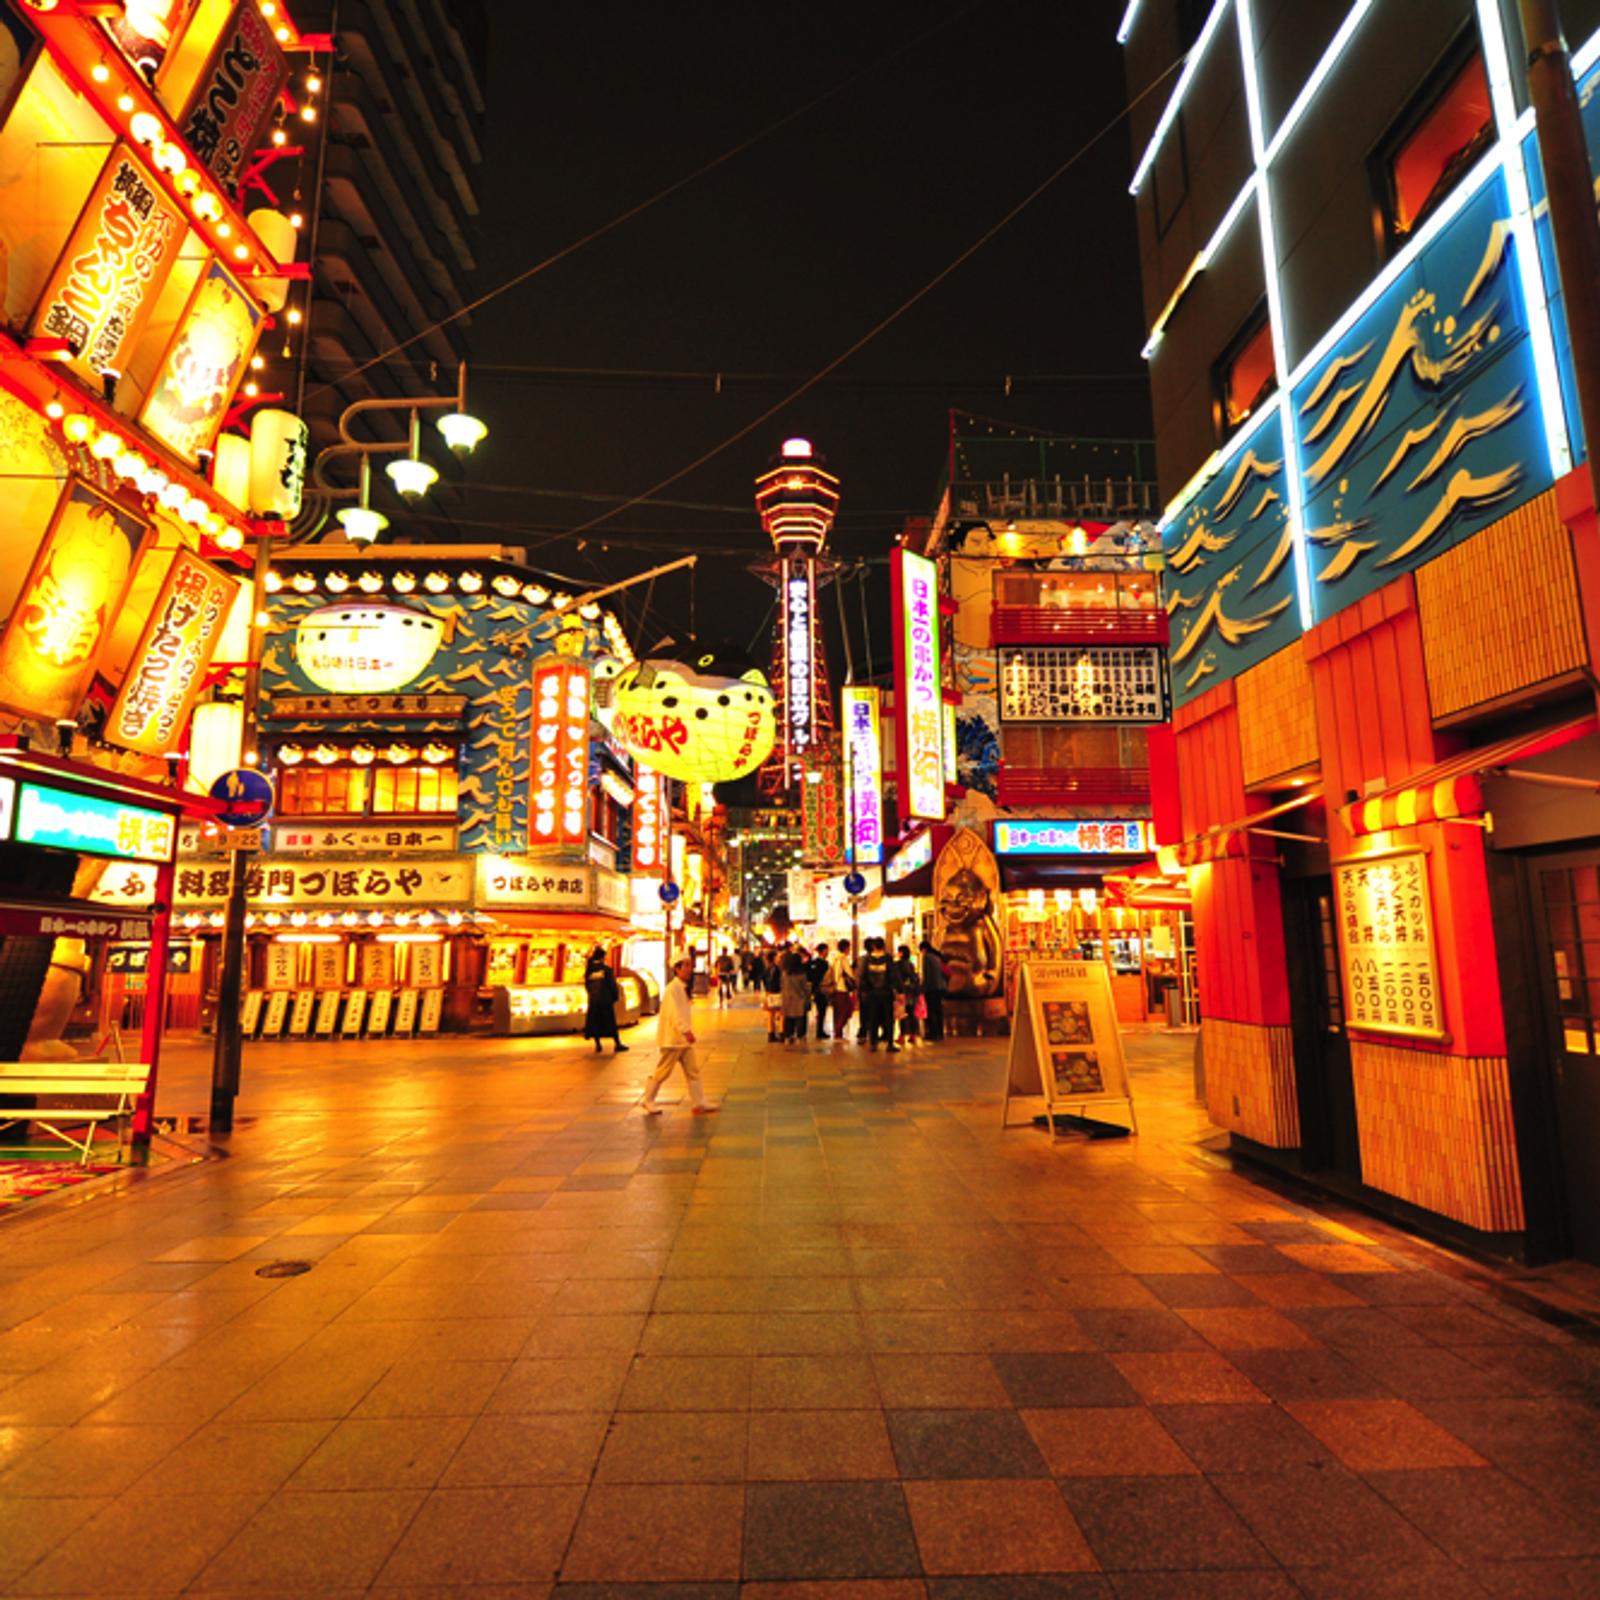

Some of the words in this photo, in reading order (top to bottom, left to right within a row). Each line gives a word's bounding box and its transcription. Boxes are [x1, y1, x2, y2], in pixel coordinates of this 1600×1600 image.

[121, 565, 208, 738] 揚げたこ焼き
[109, 950, 187, 967] づぼや
